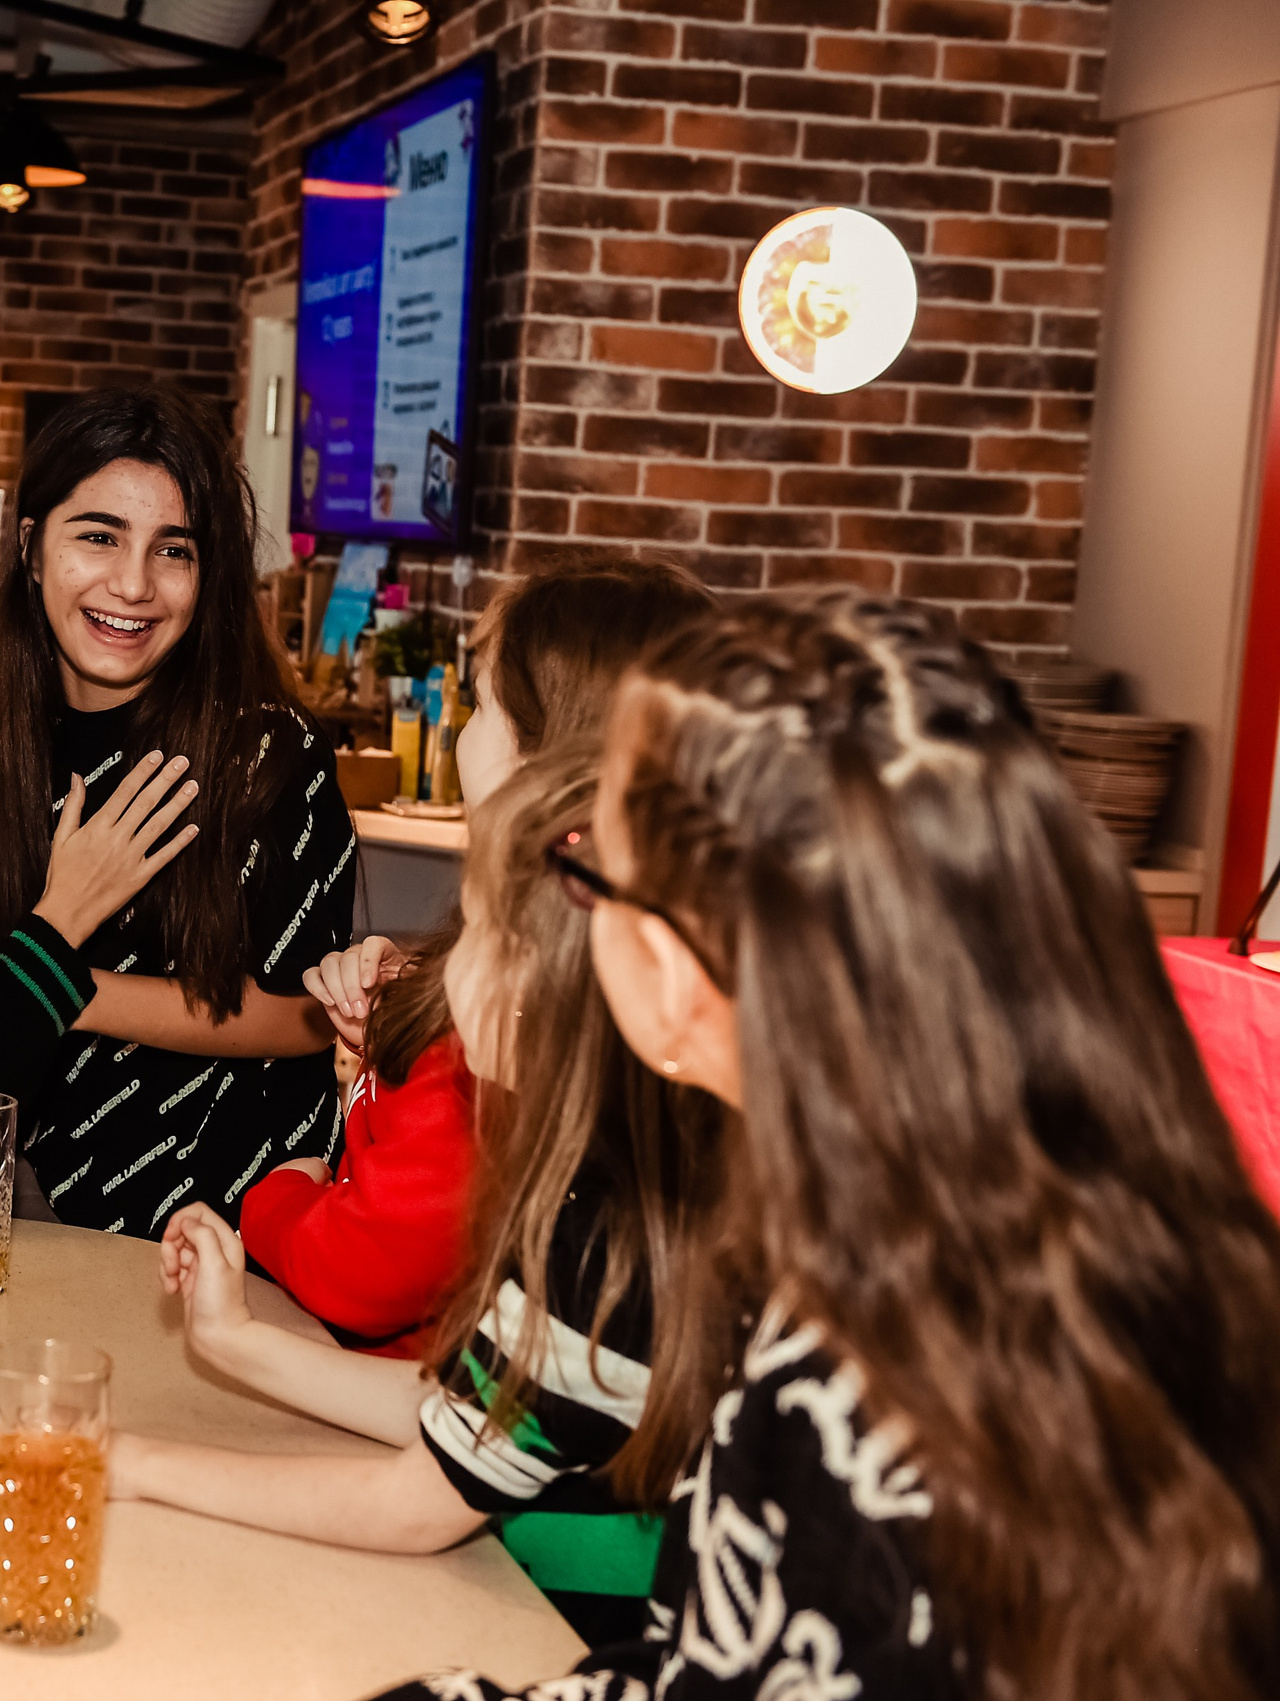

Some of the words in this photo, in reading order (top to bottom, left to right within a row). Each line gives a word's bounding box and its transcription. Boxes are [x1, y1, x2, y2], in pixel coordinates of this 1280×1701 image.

[91, 1079, 140, 1124] LAGERFELD
[284, 1120, 313, 1150] KARL
[102, 1173, 125, 1196] KARL
[123, 1135, 177, 1179] LAGERFELD
[224, 1141, 271, 1203] LAGERFELD
